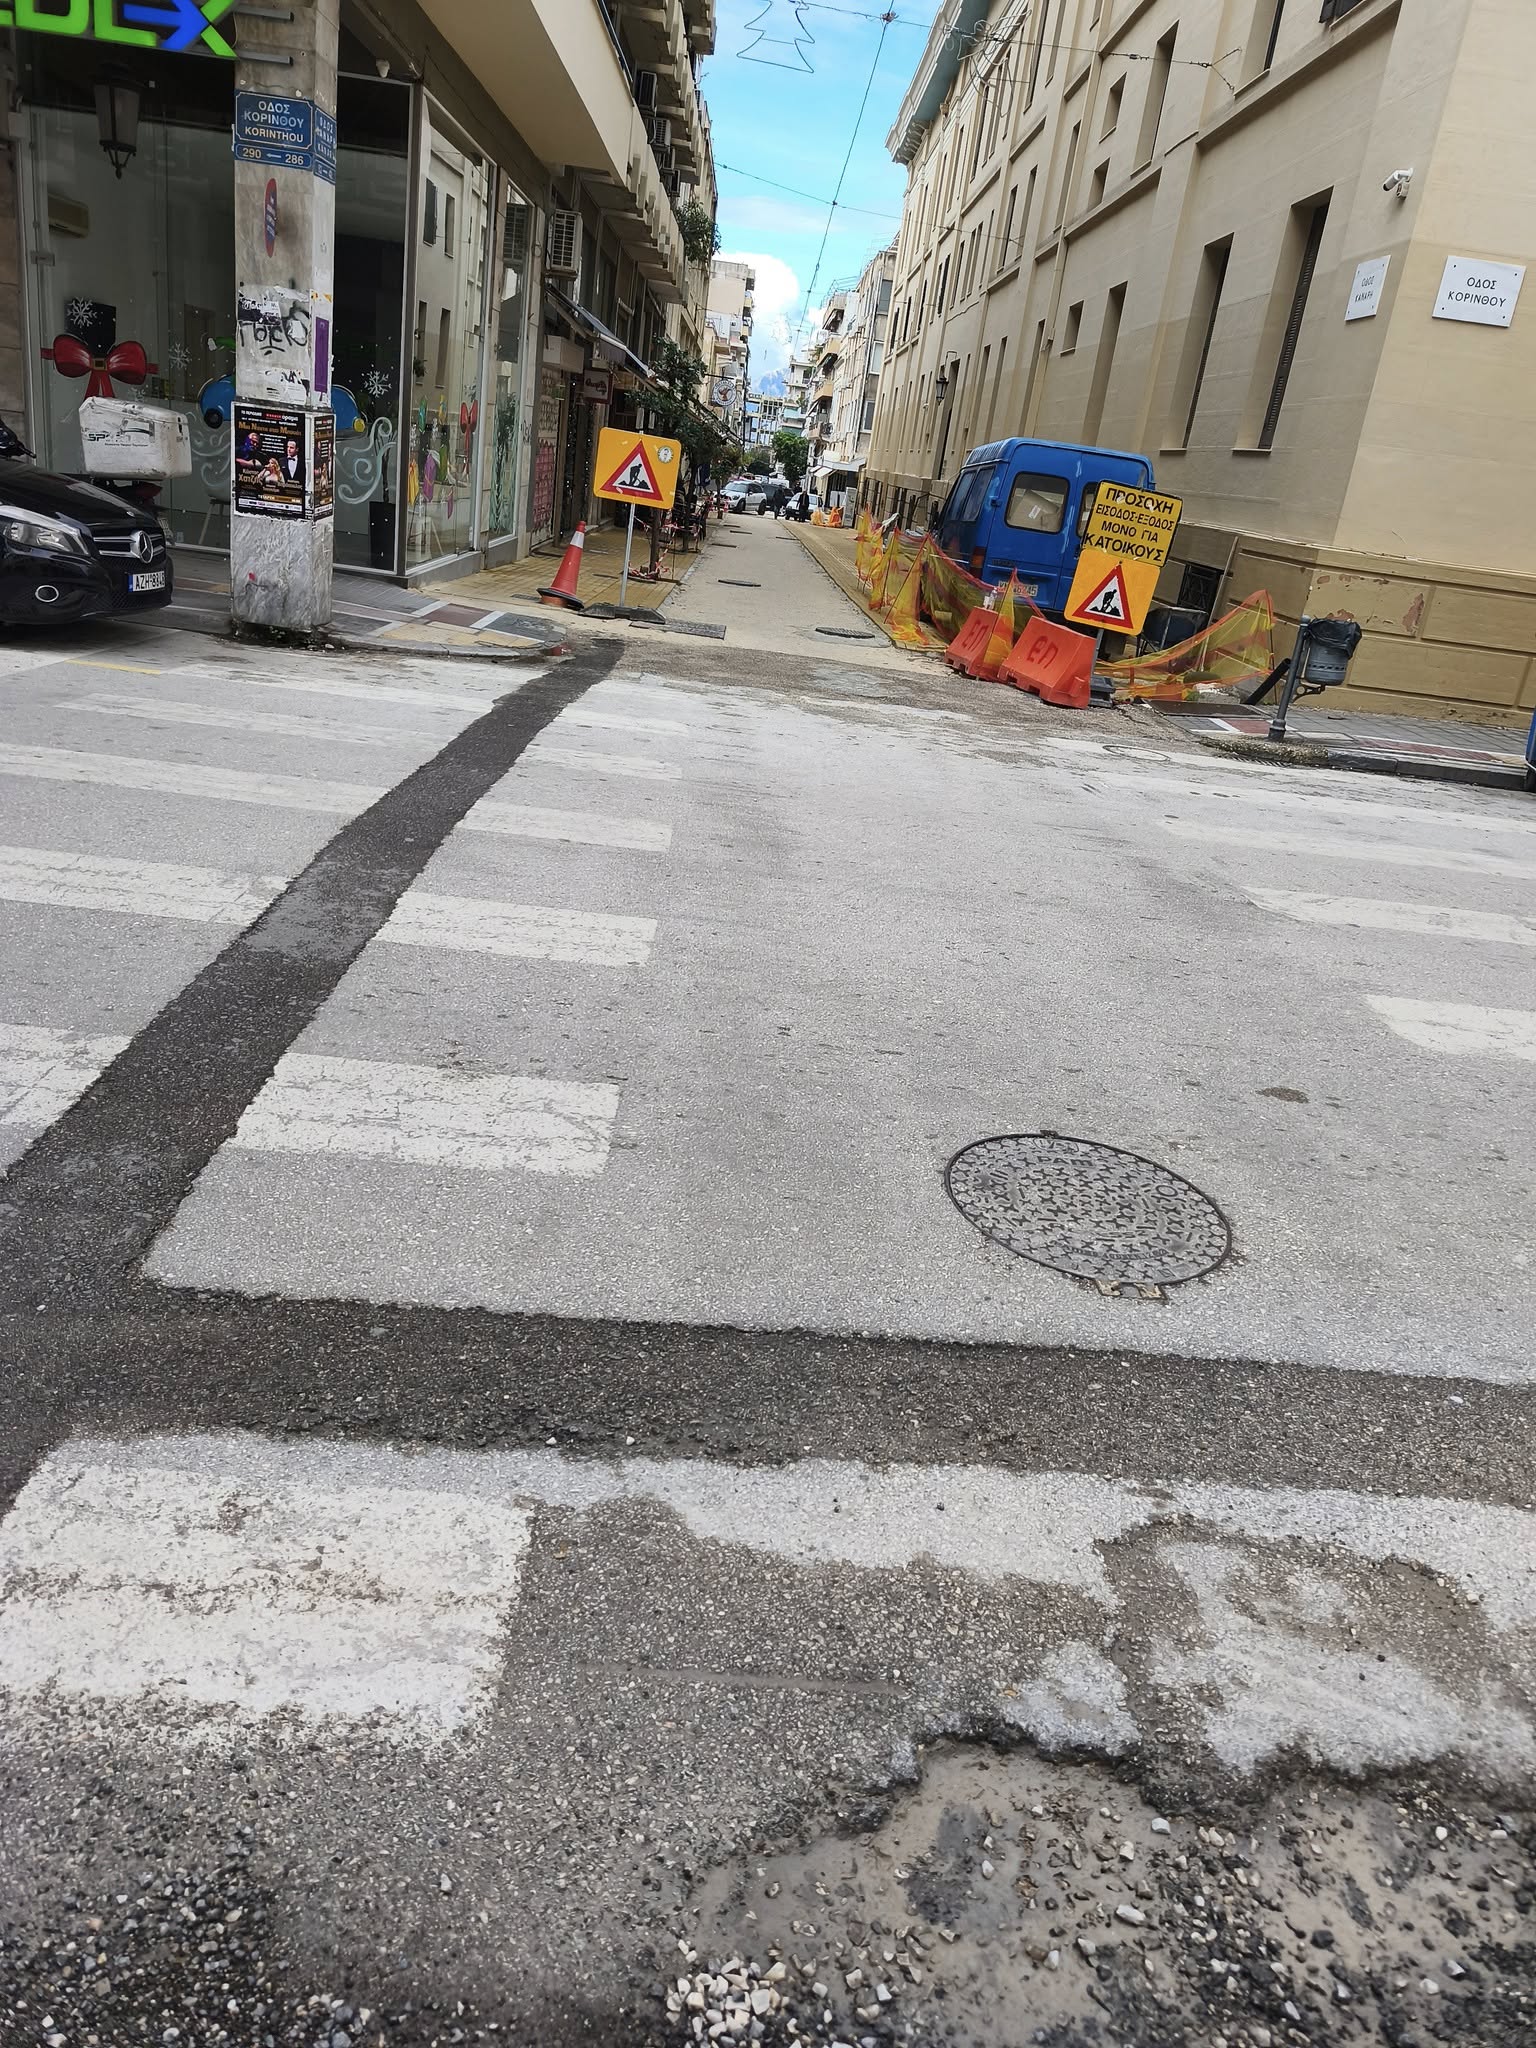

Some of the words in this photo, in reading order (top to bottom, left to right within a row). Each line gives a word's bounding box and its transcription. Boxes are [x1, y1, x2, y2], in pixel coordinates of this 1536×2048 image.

[258, 100, 290, 115] ΟΔΟΣ
[243, 110, 304, 128] ΚΟΡΙΝΘΟΥ
[244, 126, 304, 143] KORINTHOU
[242, 147, 262, 159] 290
[285, 153, 304, 165] 286
[1466, 276, 1498, 290] ΟΔΟΣ
[1447, 290, 1507, 308] ΚΟΡΙΝΘΟΥ
[1105, 487, 1175, 515] ΠΡΟΣΟΧΗ
[1095, 503, 1175, 531] ΕΙΣΟΔΟΣ-ΕΞΟΔΟΣ
[1100, 520, 1137, 538] ΜΟΝΟ
[1140, 529, 1159, 543] ΓΙΑ
[1084, 532, 1165, 562] ΚΑΤΟΙΚΟΥΣ
